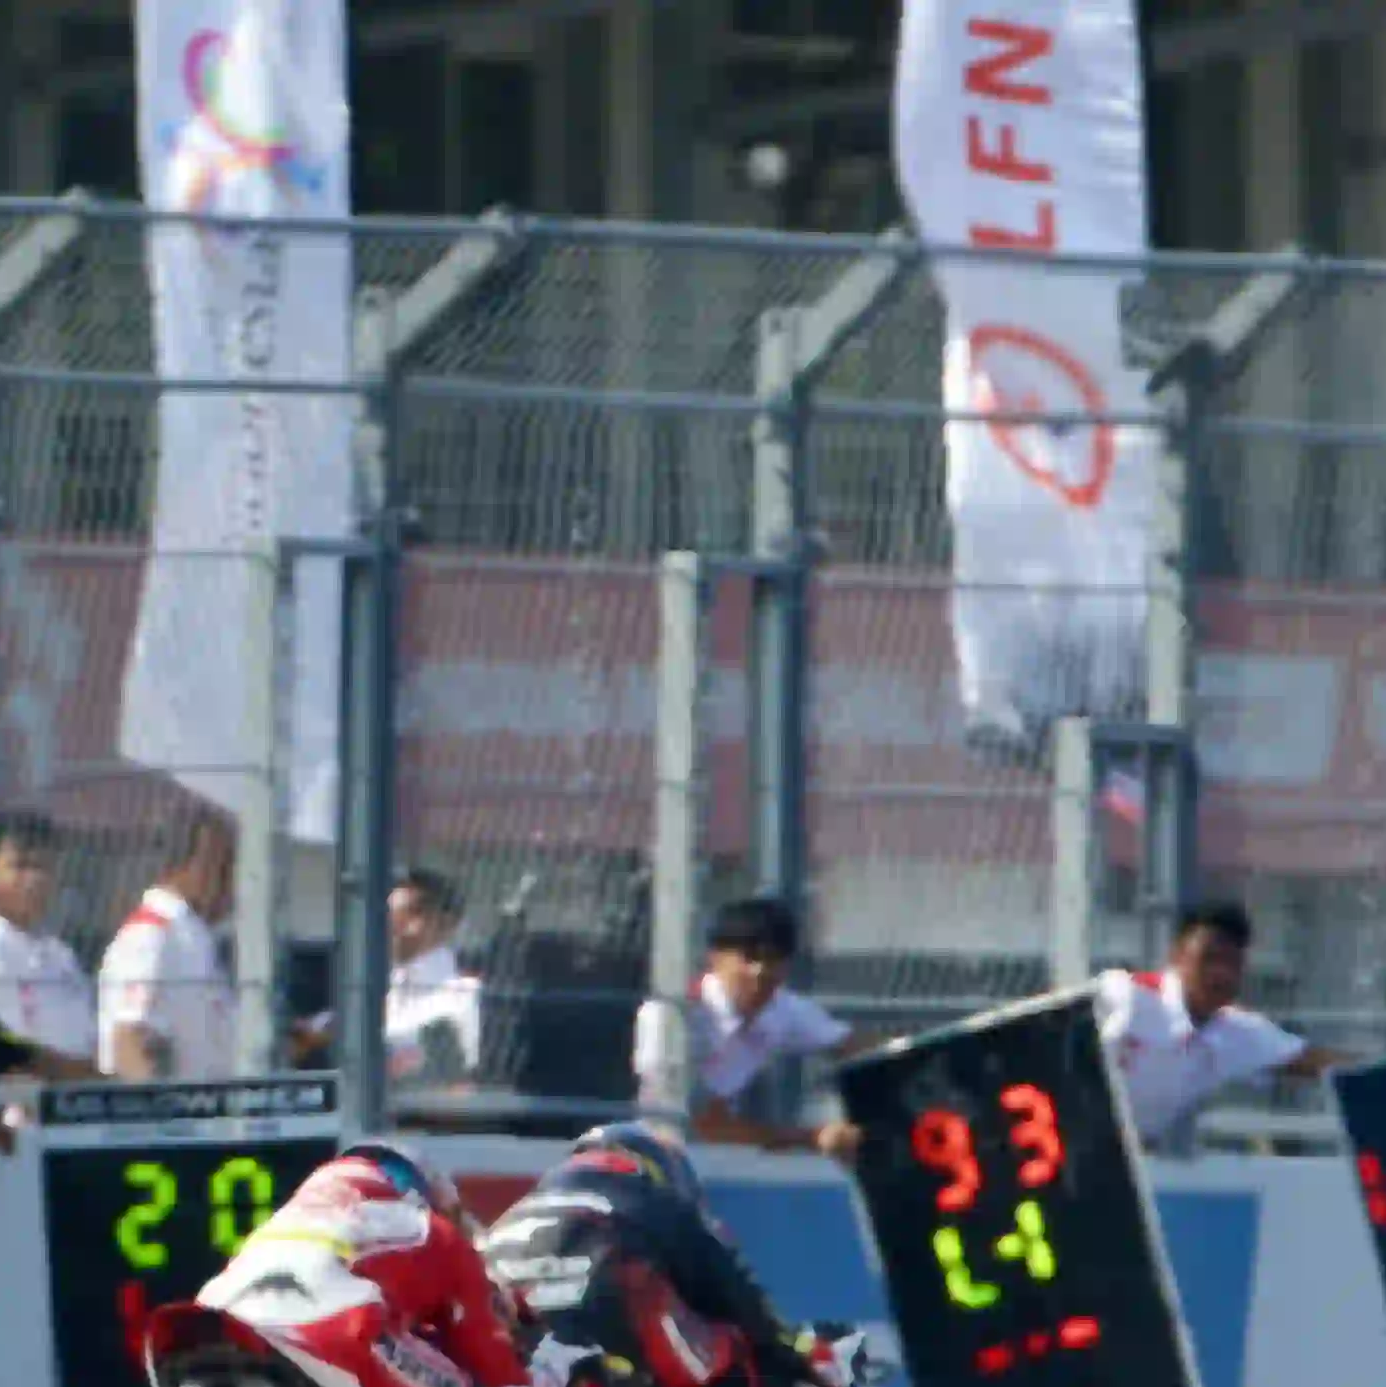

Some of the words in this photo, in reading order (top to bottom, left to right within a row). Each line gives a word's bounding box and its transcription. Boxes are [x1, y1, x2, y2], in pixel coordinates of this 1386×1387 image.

[963, 18, 1055, 256] LFN
[912, 1083, 1065, 1211] 93
[116, 1156, 274, 1270] 20
